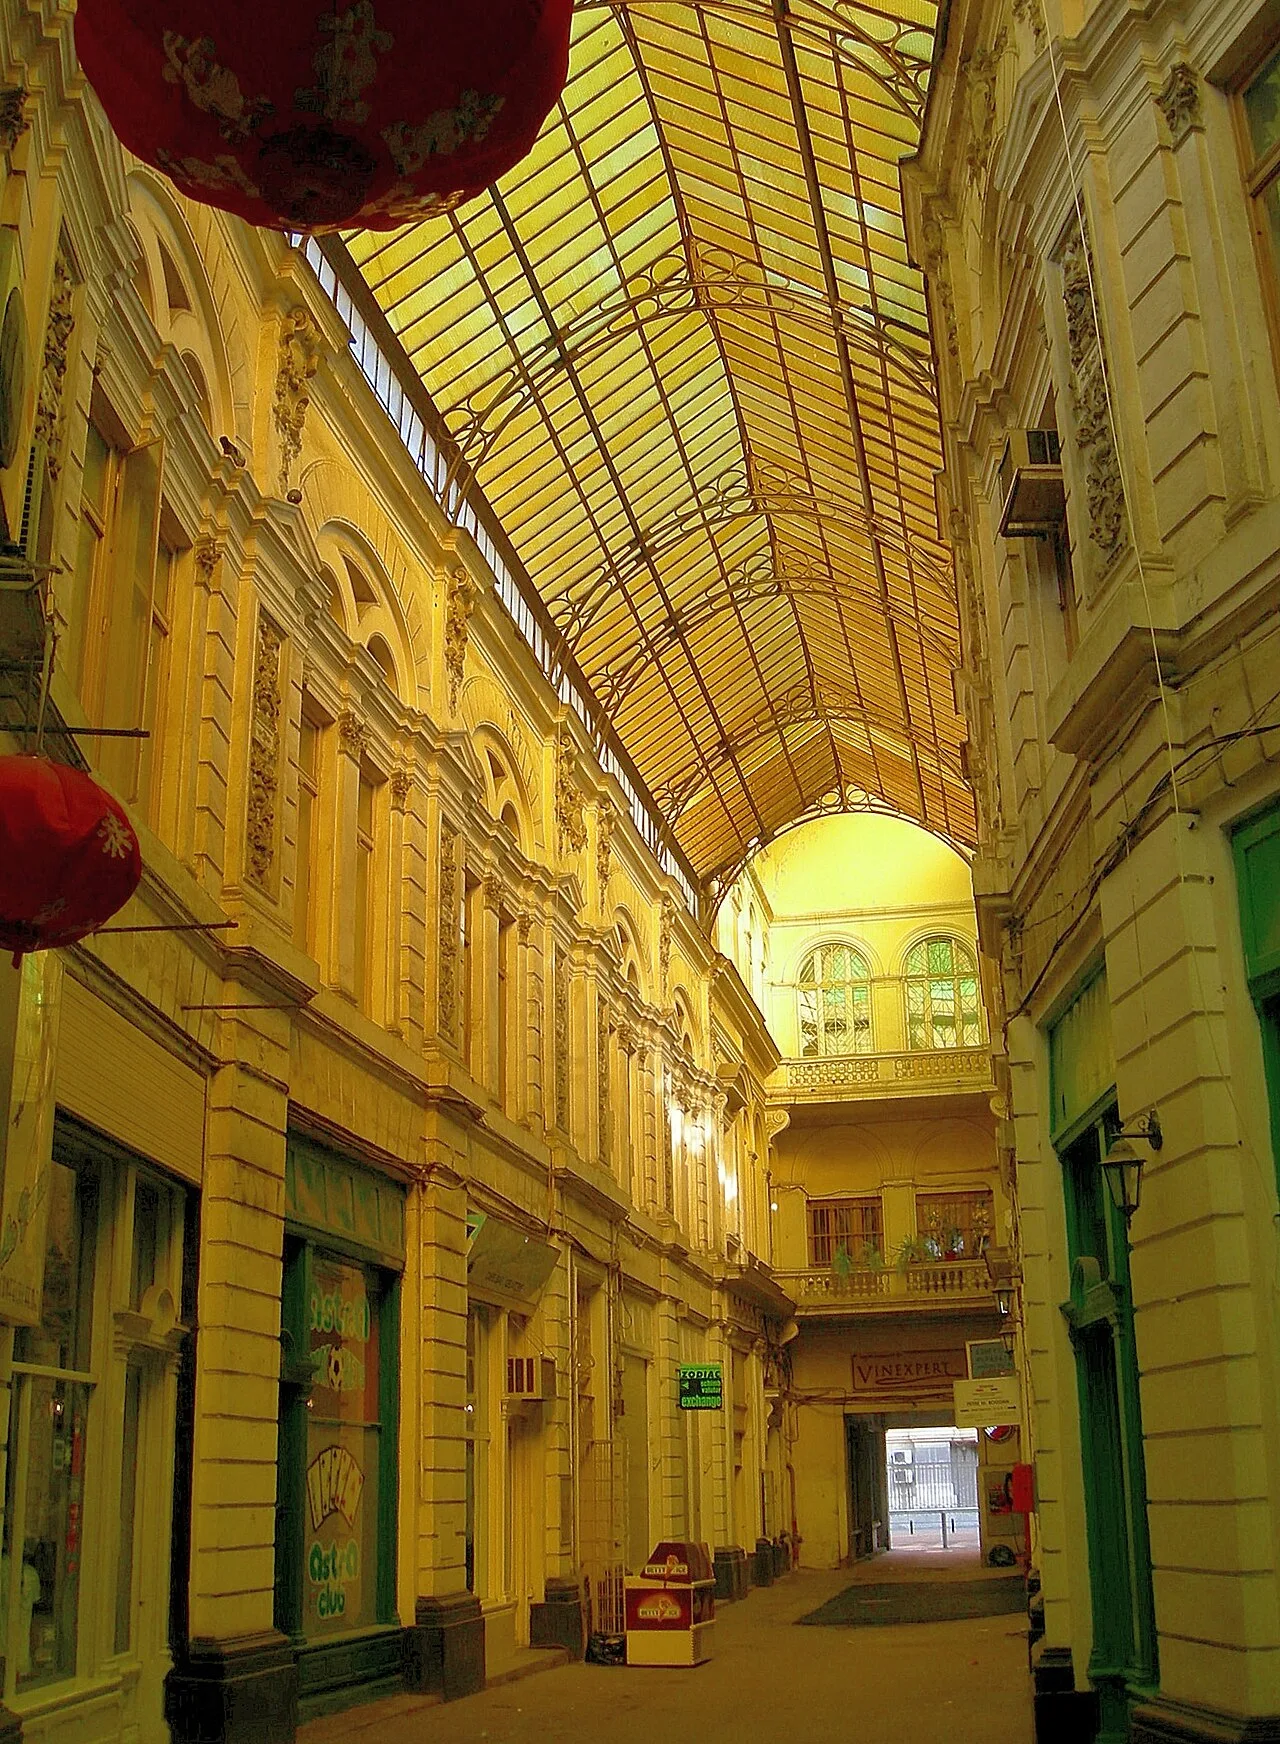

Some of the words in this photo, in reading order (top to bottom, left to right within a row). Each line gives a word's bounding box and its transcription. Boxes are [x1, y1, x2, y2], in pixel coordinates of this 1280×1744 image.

[681, 1370, 721, 1379] ZODIAC
[856, 1361, 958, 1385] VINEXPERT
[681, 1395, 722, 1408] exchange
